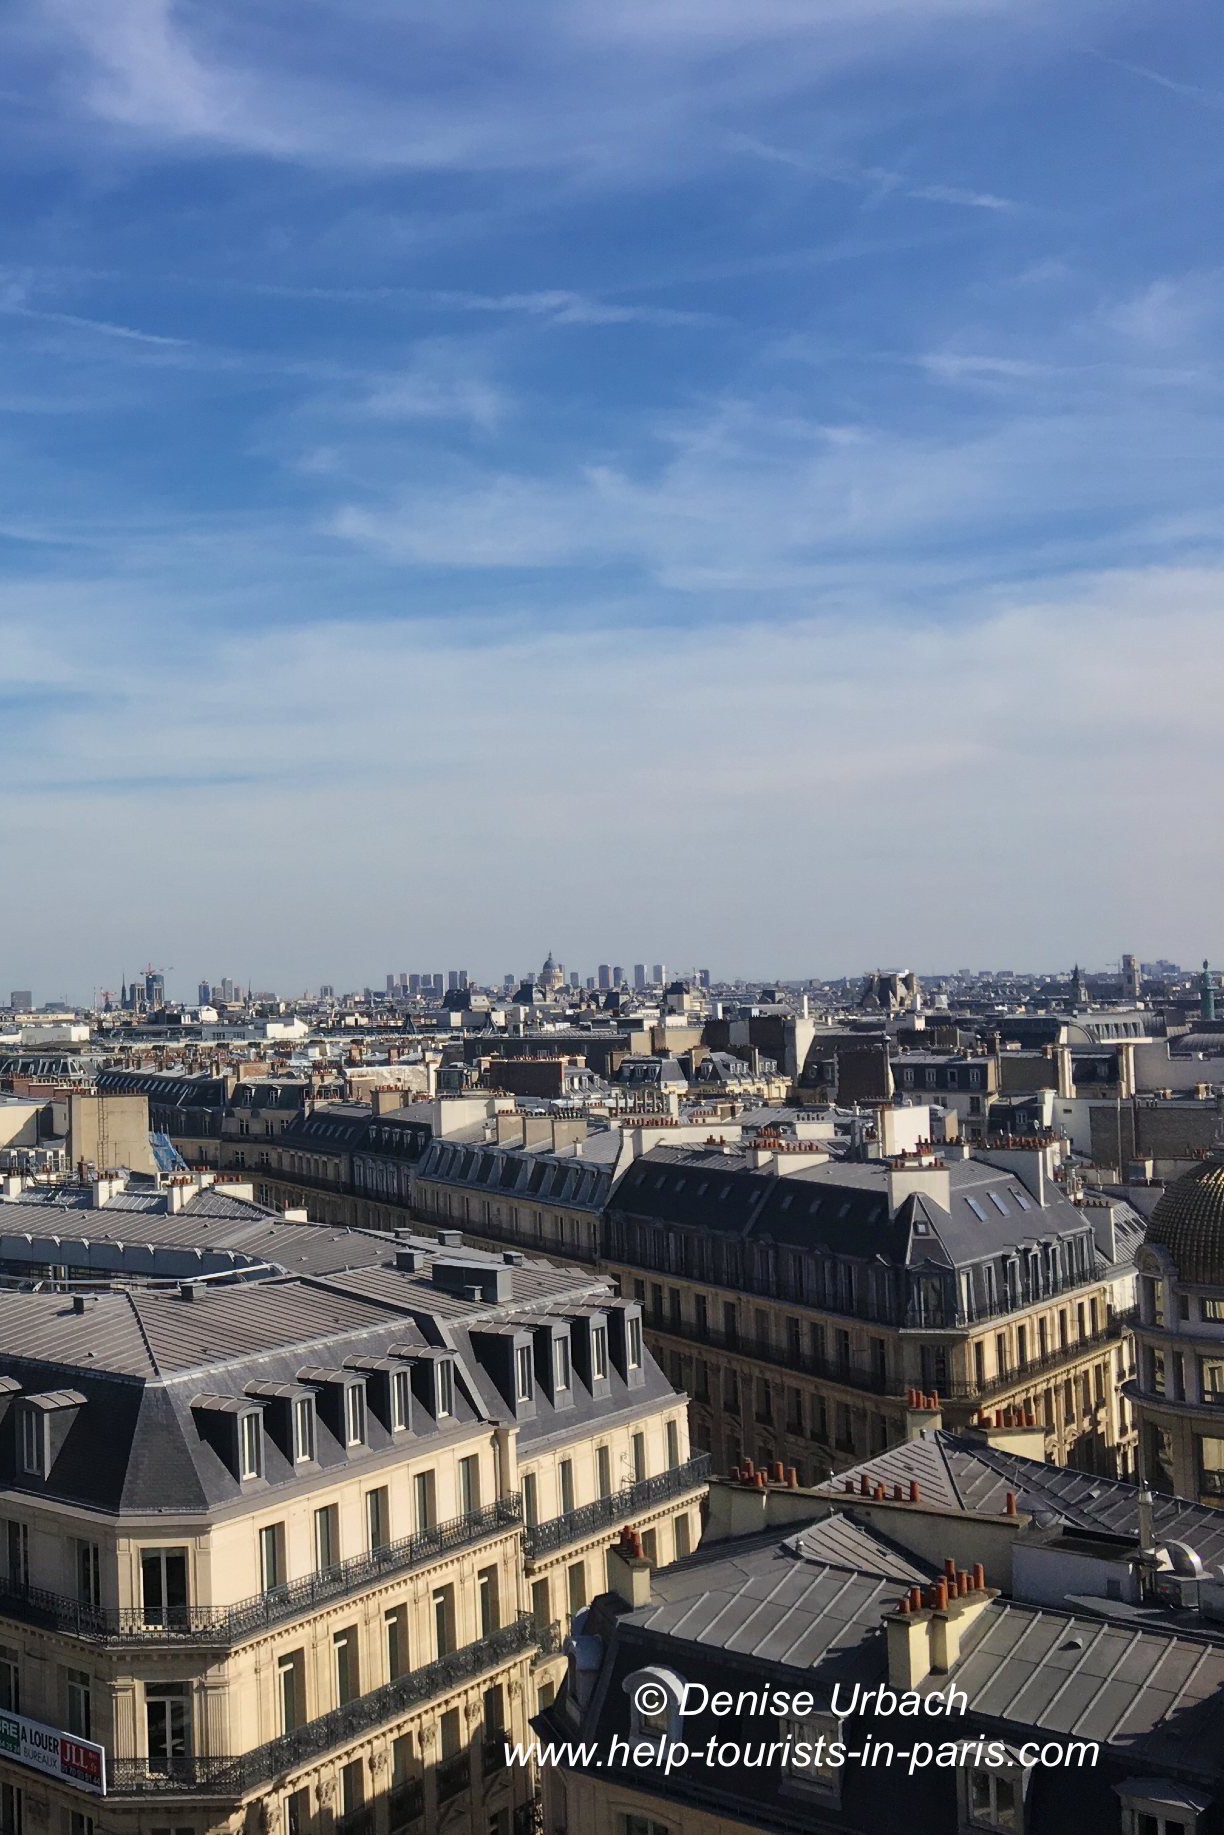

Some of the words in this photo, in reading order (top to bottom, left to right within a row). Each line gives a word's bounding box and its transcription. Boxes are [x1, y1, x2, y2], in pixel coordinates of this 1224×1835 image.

[21, 1725, 27, 1743] A
[30, 1730, 59, 1755] LOUER
[24, 1748, 57, 1769] BUREAUX
[63, 1743, 88, 1769] JLL
